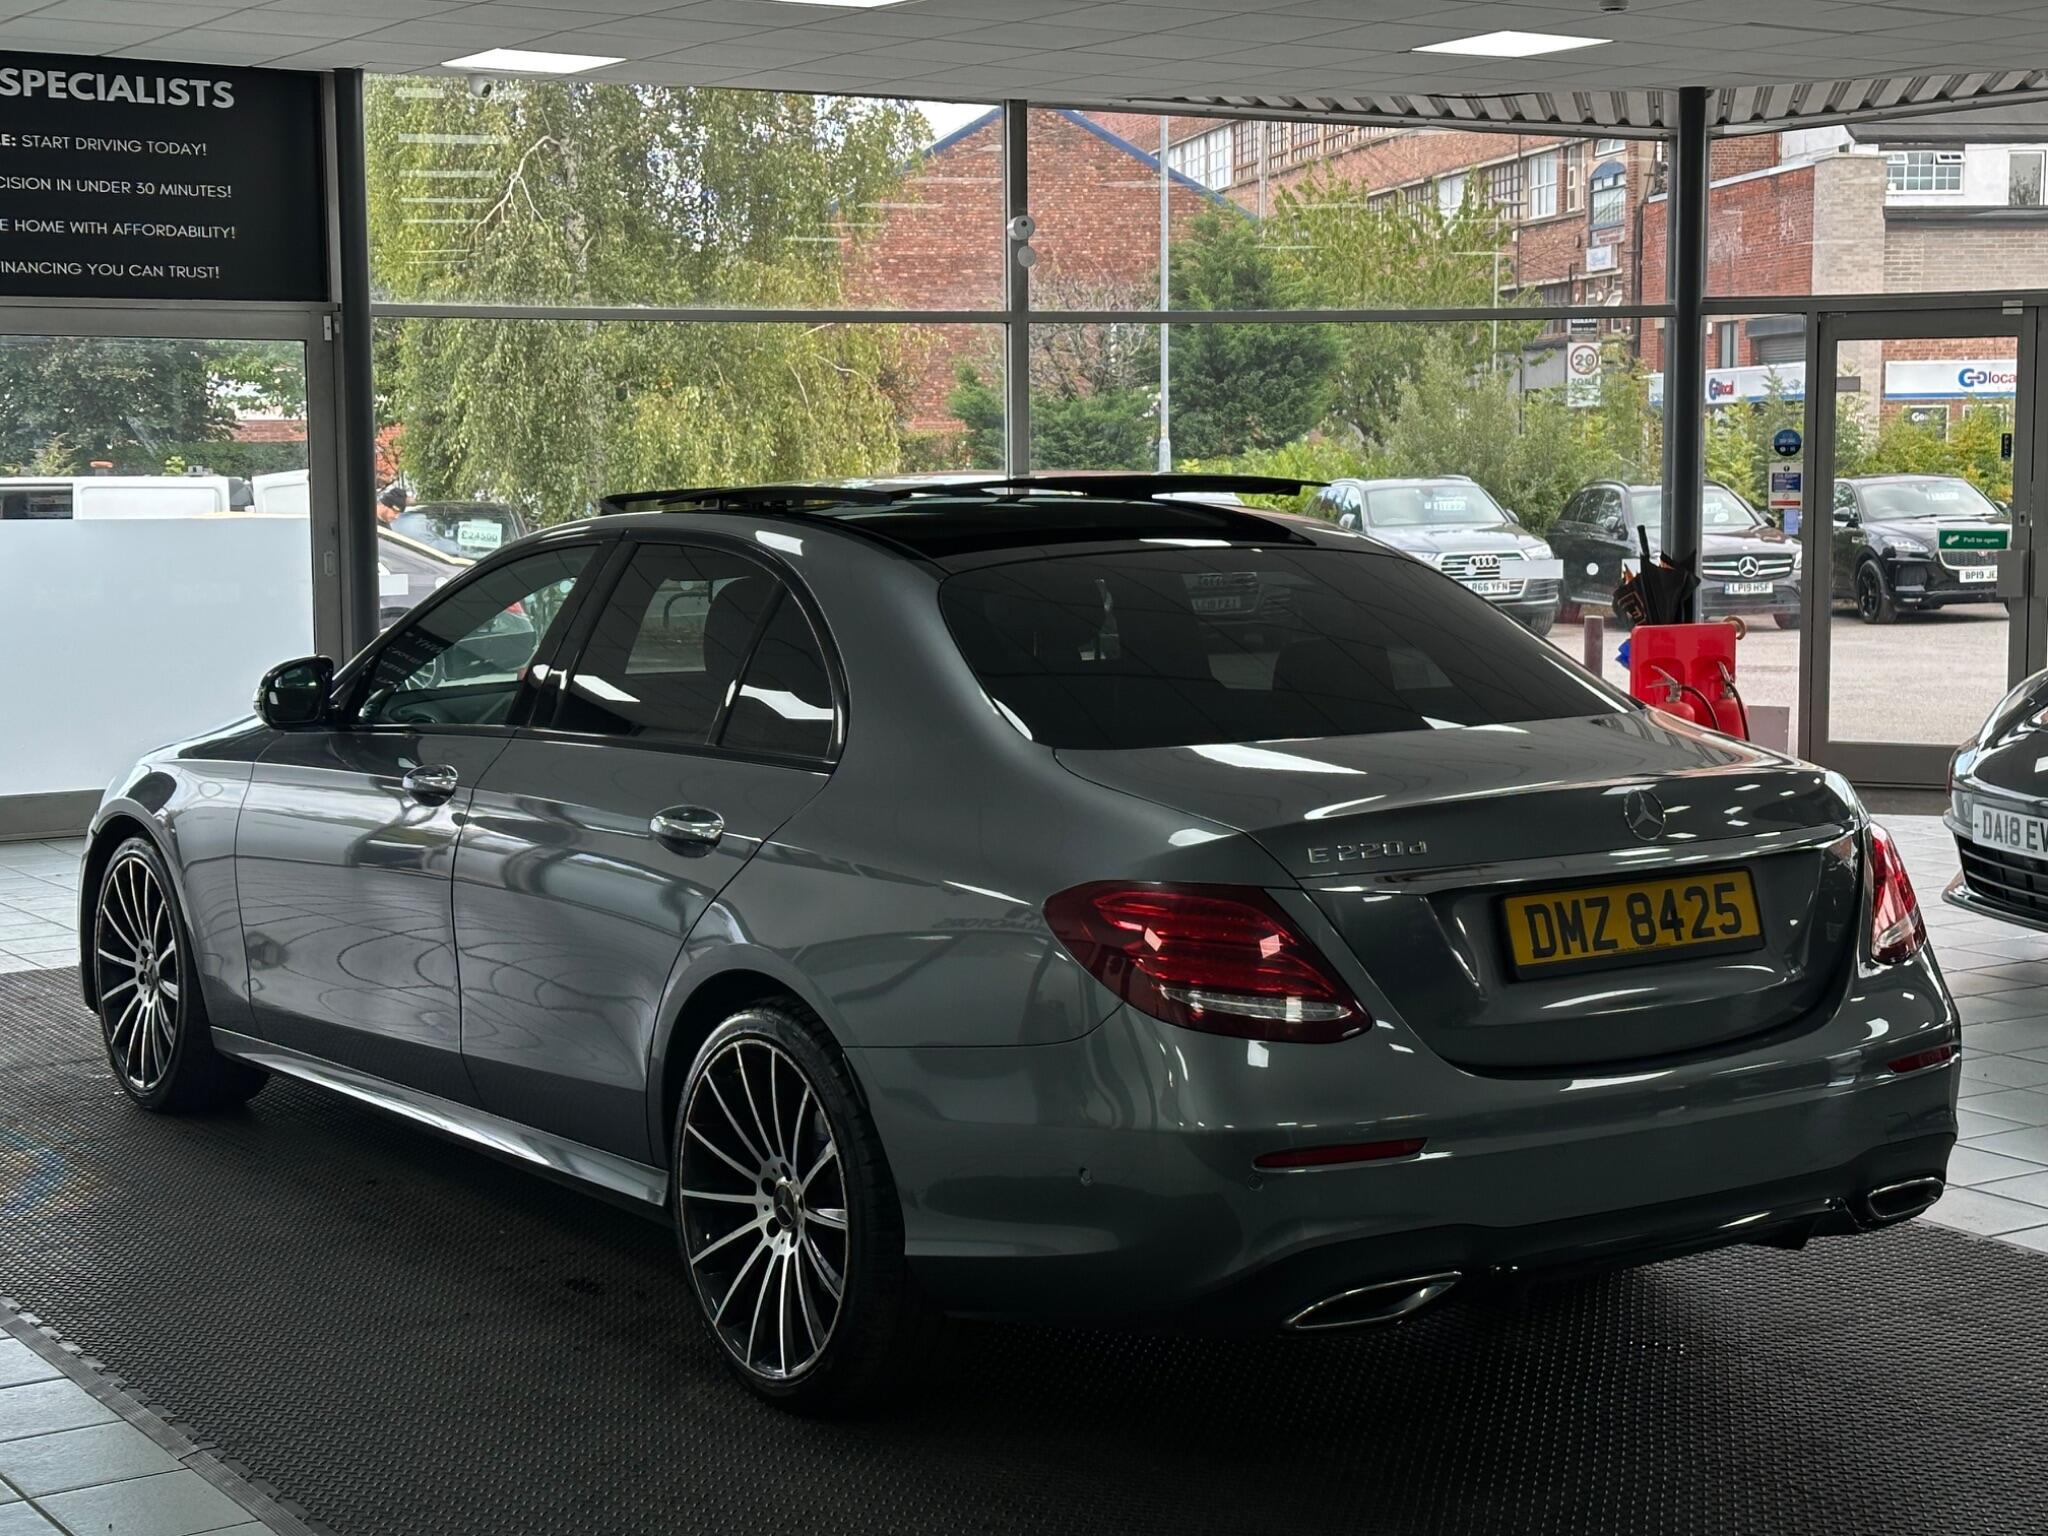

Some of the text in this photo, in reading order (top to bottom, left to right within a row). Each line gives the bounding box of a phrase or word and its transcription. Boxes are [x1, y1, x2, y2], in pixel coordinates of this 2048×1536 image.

[0, 68, 234, 108] SPECIALISTS
[0, 134, 207, 156] E: START DRIVING TODAY!
[57, 179, 71, 191] IN
[77, 180, 131, 193] UNDER
[136, 182, 155, 195] 30
[160, 184, 232, 198] MINUTES!
[15, 219, 64, 233] HOME
[70, 221, 107, 234] WITH
[112, 223, 235, 239] AFFORDABILITY!
[87, 263, 124, 276] YOU
[128, 264, 164, 277] CAN
[168, 265, 220, 279] TRUST!
[1575, 354, 1594, 366] 20
[1965, 571, 1984, 579] BP19
[1491, 581, 1508, 590] YFN
[1732, 583, 1752, 592] LP19
[1982, 810, 2020, 846] DA18
[1307, 847, 1330, 863] E
[1524, 882, 1742, 959] DMZ 8425
